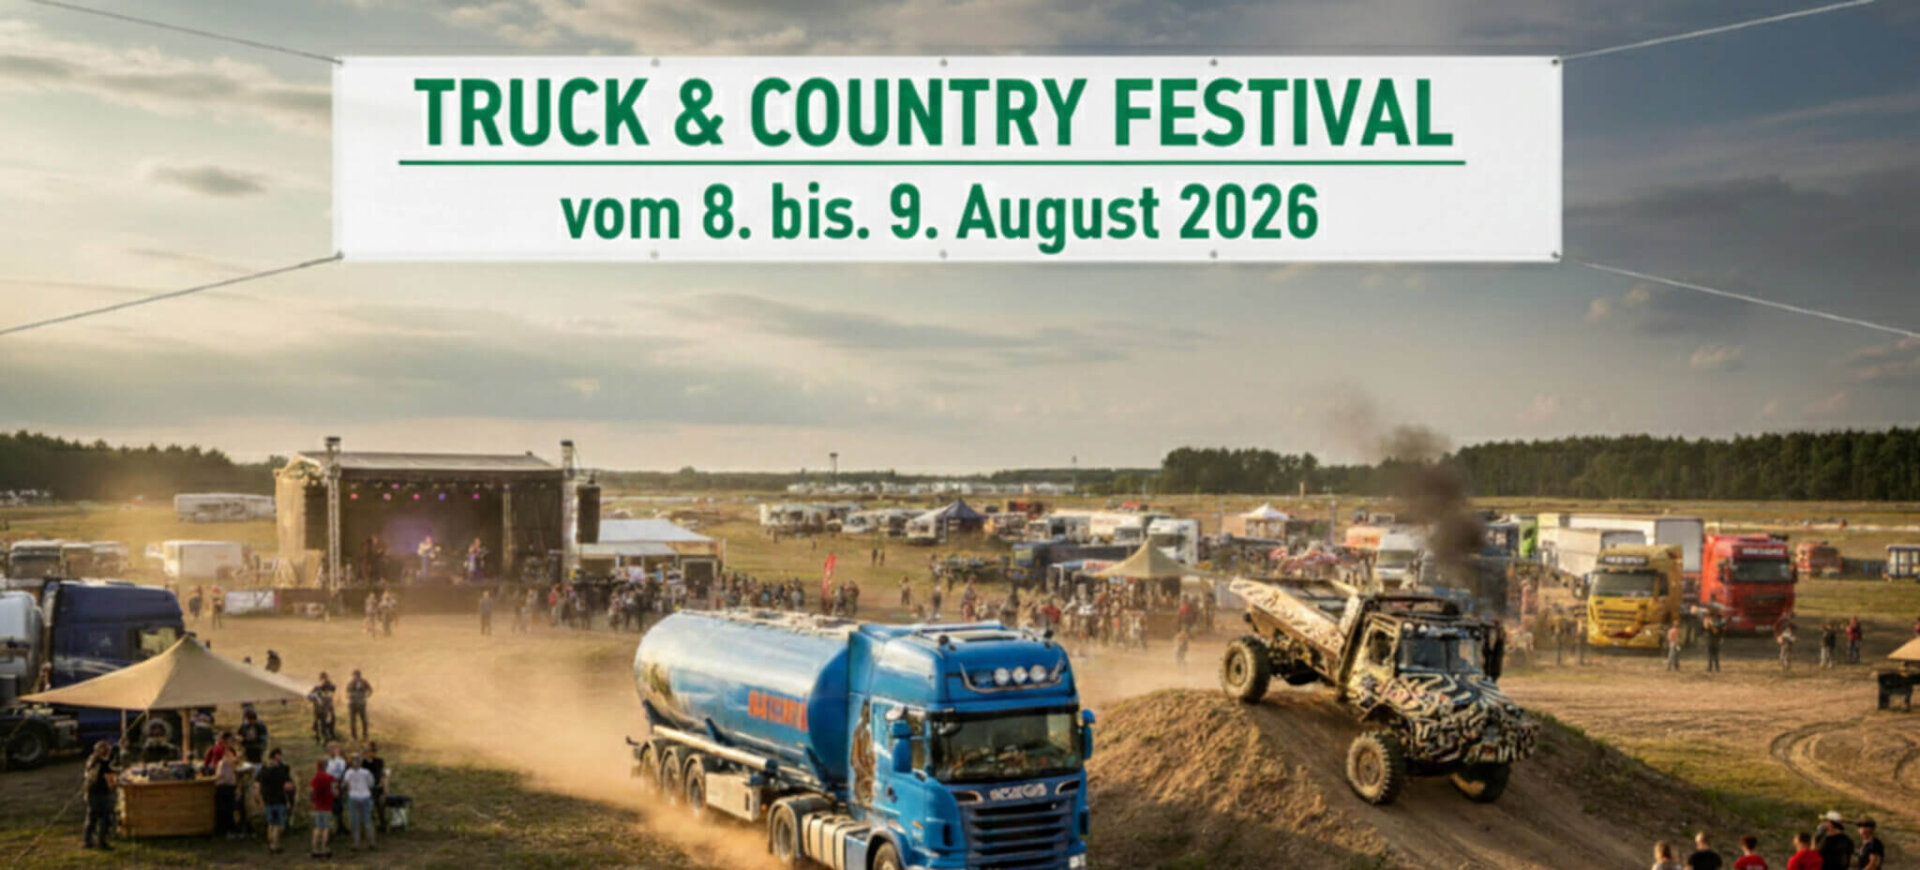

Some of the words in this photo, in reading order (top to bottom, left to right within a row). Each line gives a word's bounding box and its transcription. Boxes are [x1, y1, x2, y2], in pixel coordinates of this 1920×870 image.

[414, 77, 650, 147] TRUCK
[674, 77, 724, 147] &
[750, 77, 1088, 148] COUNTRY
[1115, 77, 1454, 147] FESTIVAL
[560, 197, 680, 240] vom
[702, 183, 751, 240] 8.
[771, 181, 870, 240] bis.
[889, 182, 938, 240] 9.
[956, 183, 1160, 255] August
[1179, 182, 1319, 240] 2026
